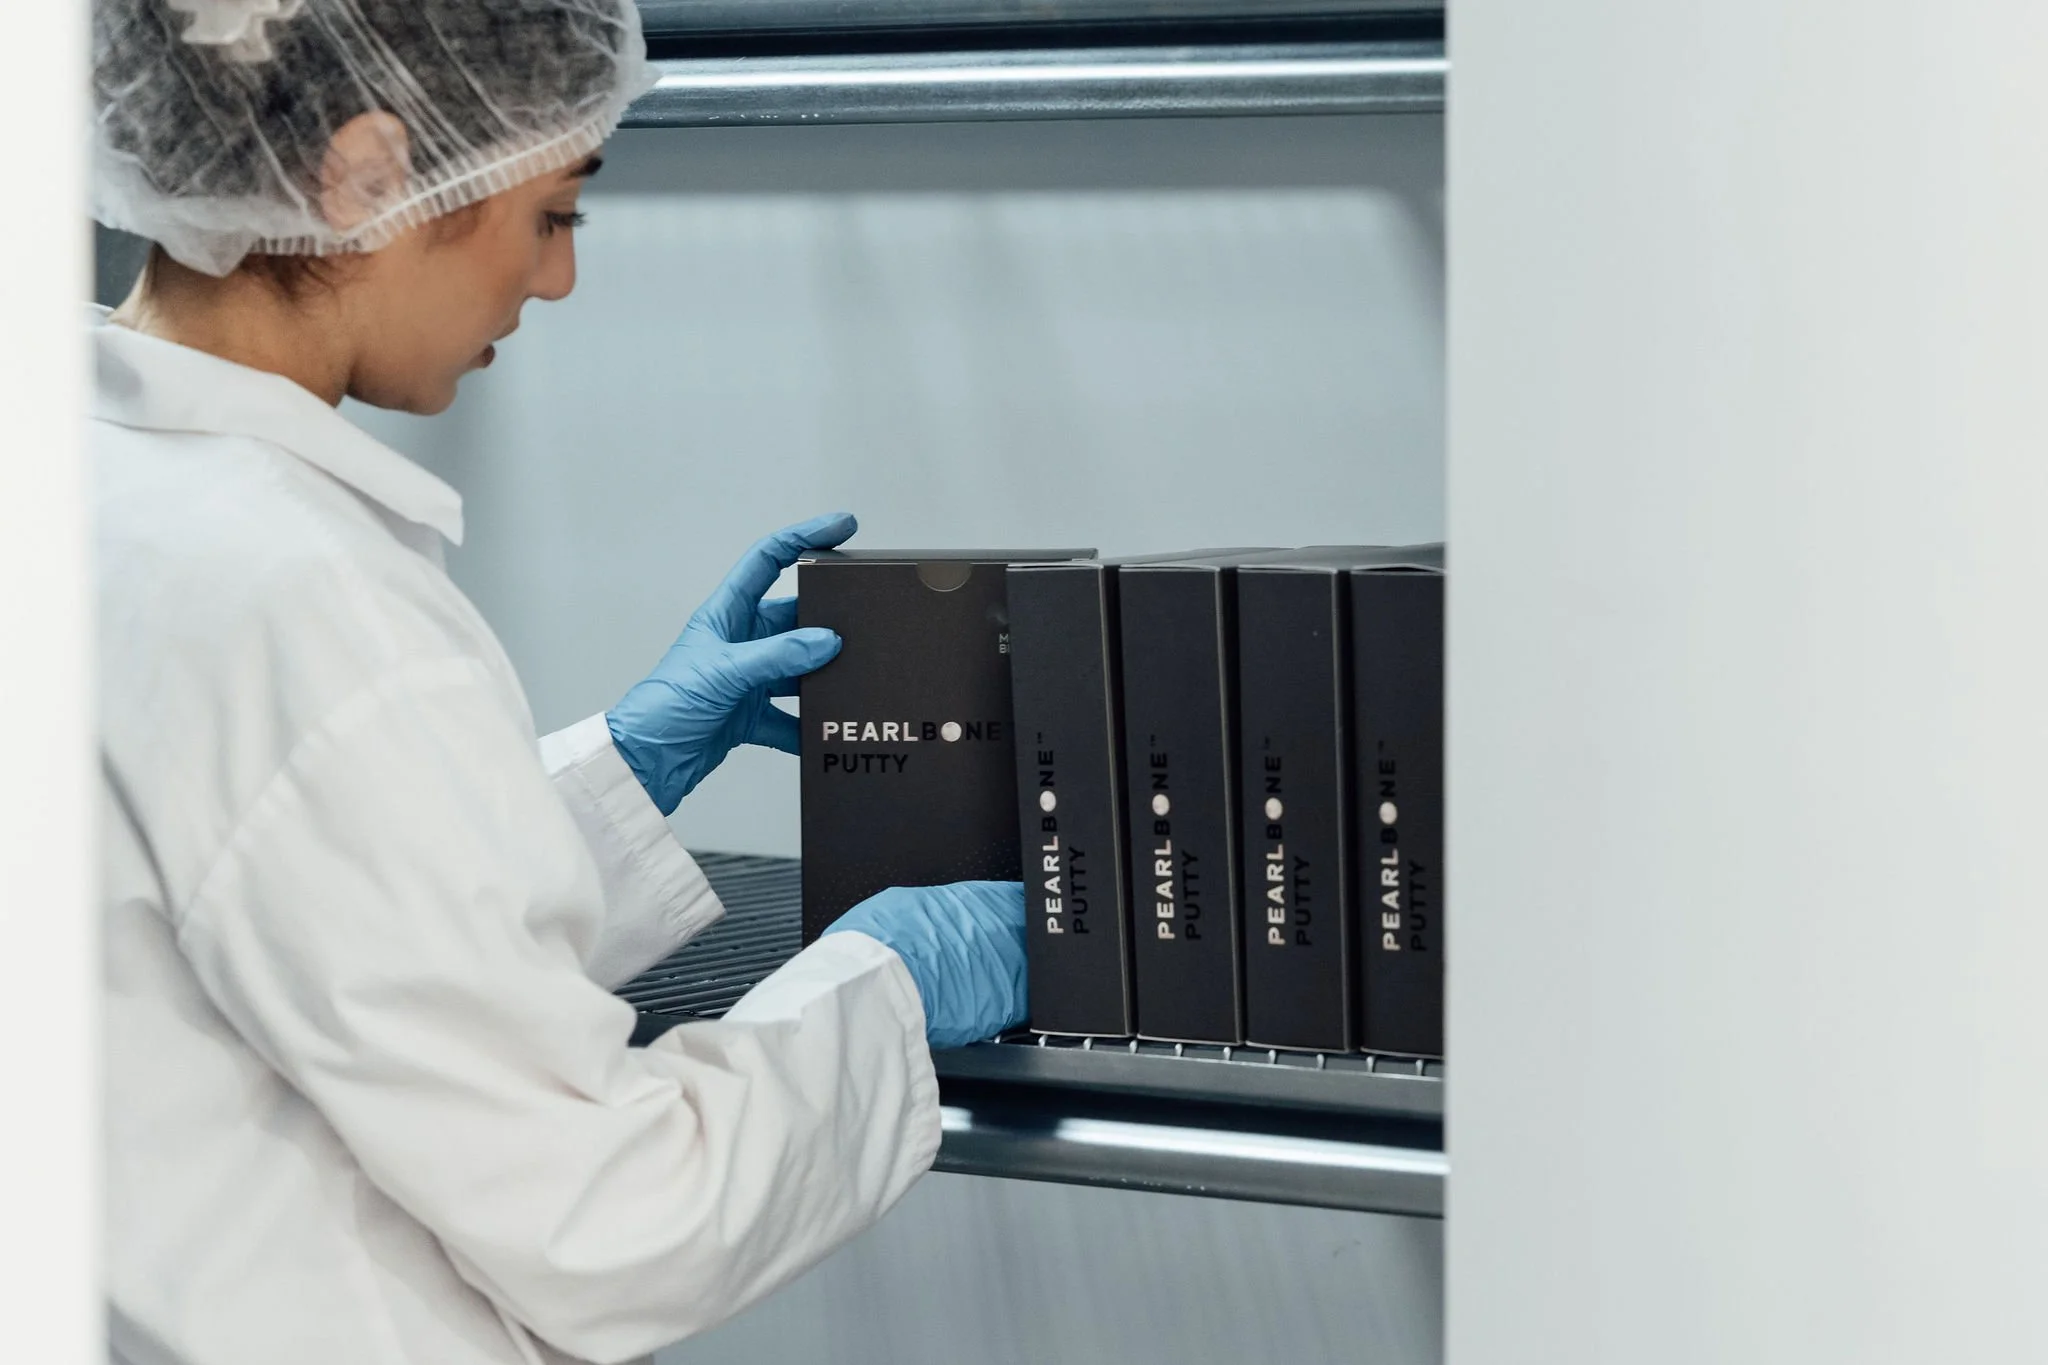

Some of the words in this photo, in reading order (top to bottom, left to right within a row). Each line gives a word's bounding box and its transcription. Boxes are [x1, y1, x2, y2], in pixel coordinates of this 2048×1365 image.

[823, 753, 908, 773] PUTTY
[1068, 846, 1089, 934] PUTTY
[1182, 850, 1201, 941] PUTTY
[1293, 856, 1313, 946] PUTTY
[1408, 860, 1427, 953] PUTTY
